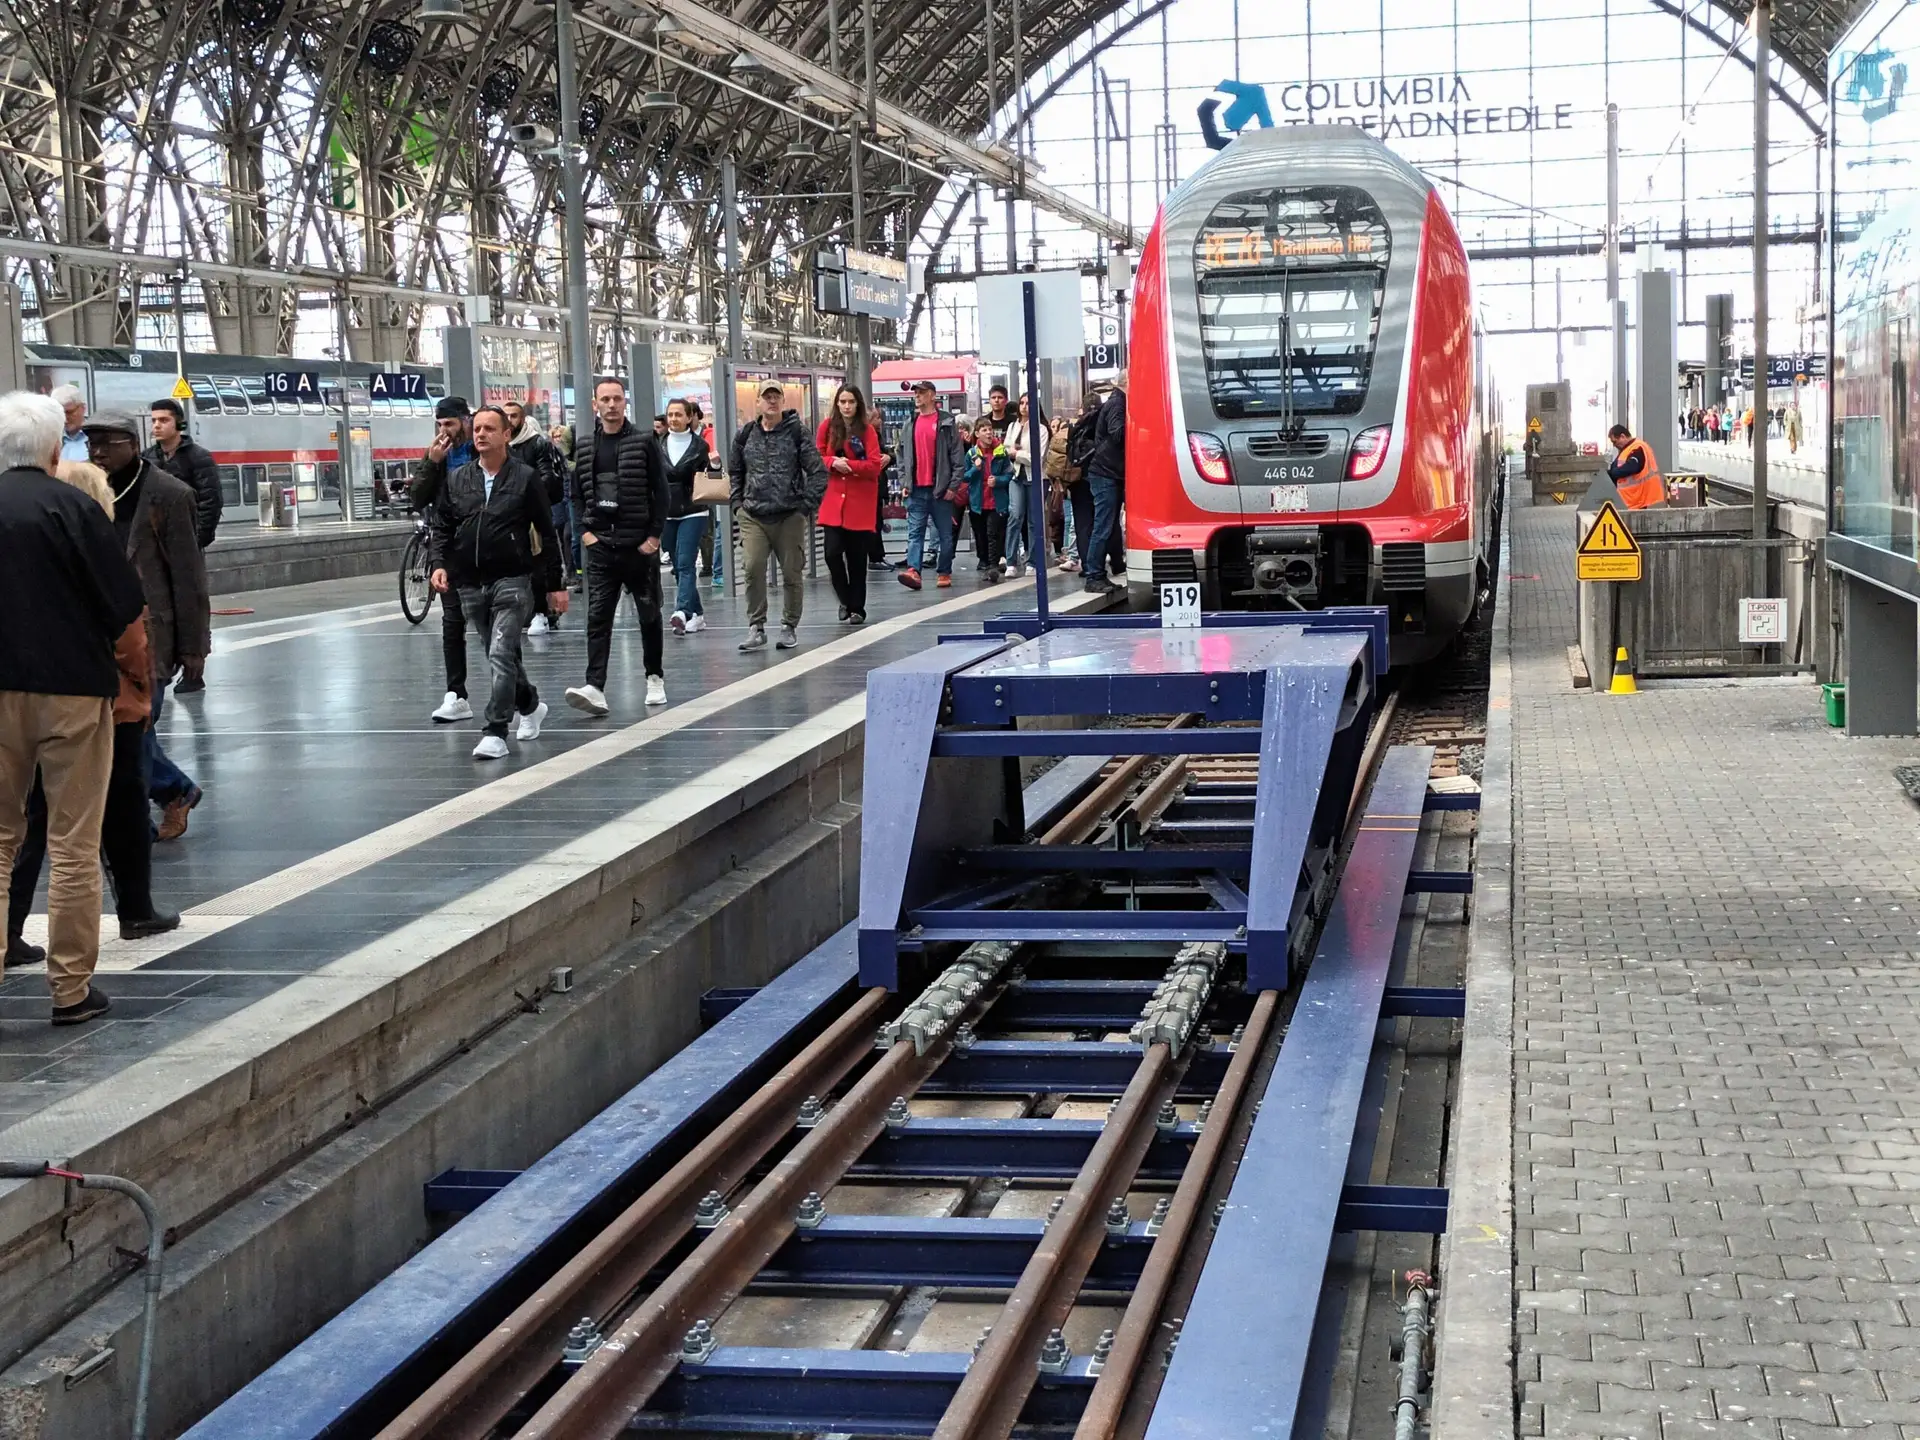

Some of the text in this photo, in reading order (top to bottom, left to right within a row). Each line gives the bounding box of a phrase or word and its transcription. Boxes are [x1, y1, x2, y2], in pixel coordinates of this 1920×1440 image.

[1281, 76, 1471, 111] COLUMBIA
[1284, 103, 1573, 140] ADNEEDLE
[1087, 344, 1108, 365] 18
[1775, 359, 1805, 372] 20 B
[267, 373, 312, 392] 16 A
[372, 374, 421, 393] A 17
[1264, 465, 1315, 480] 446 042
[1163, 586, 1198, 608] 519
[1178, 611, 1199, 620] 2010
